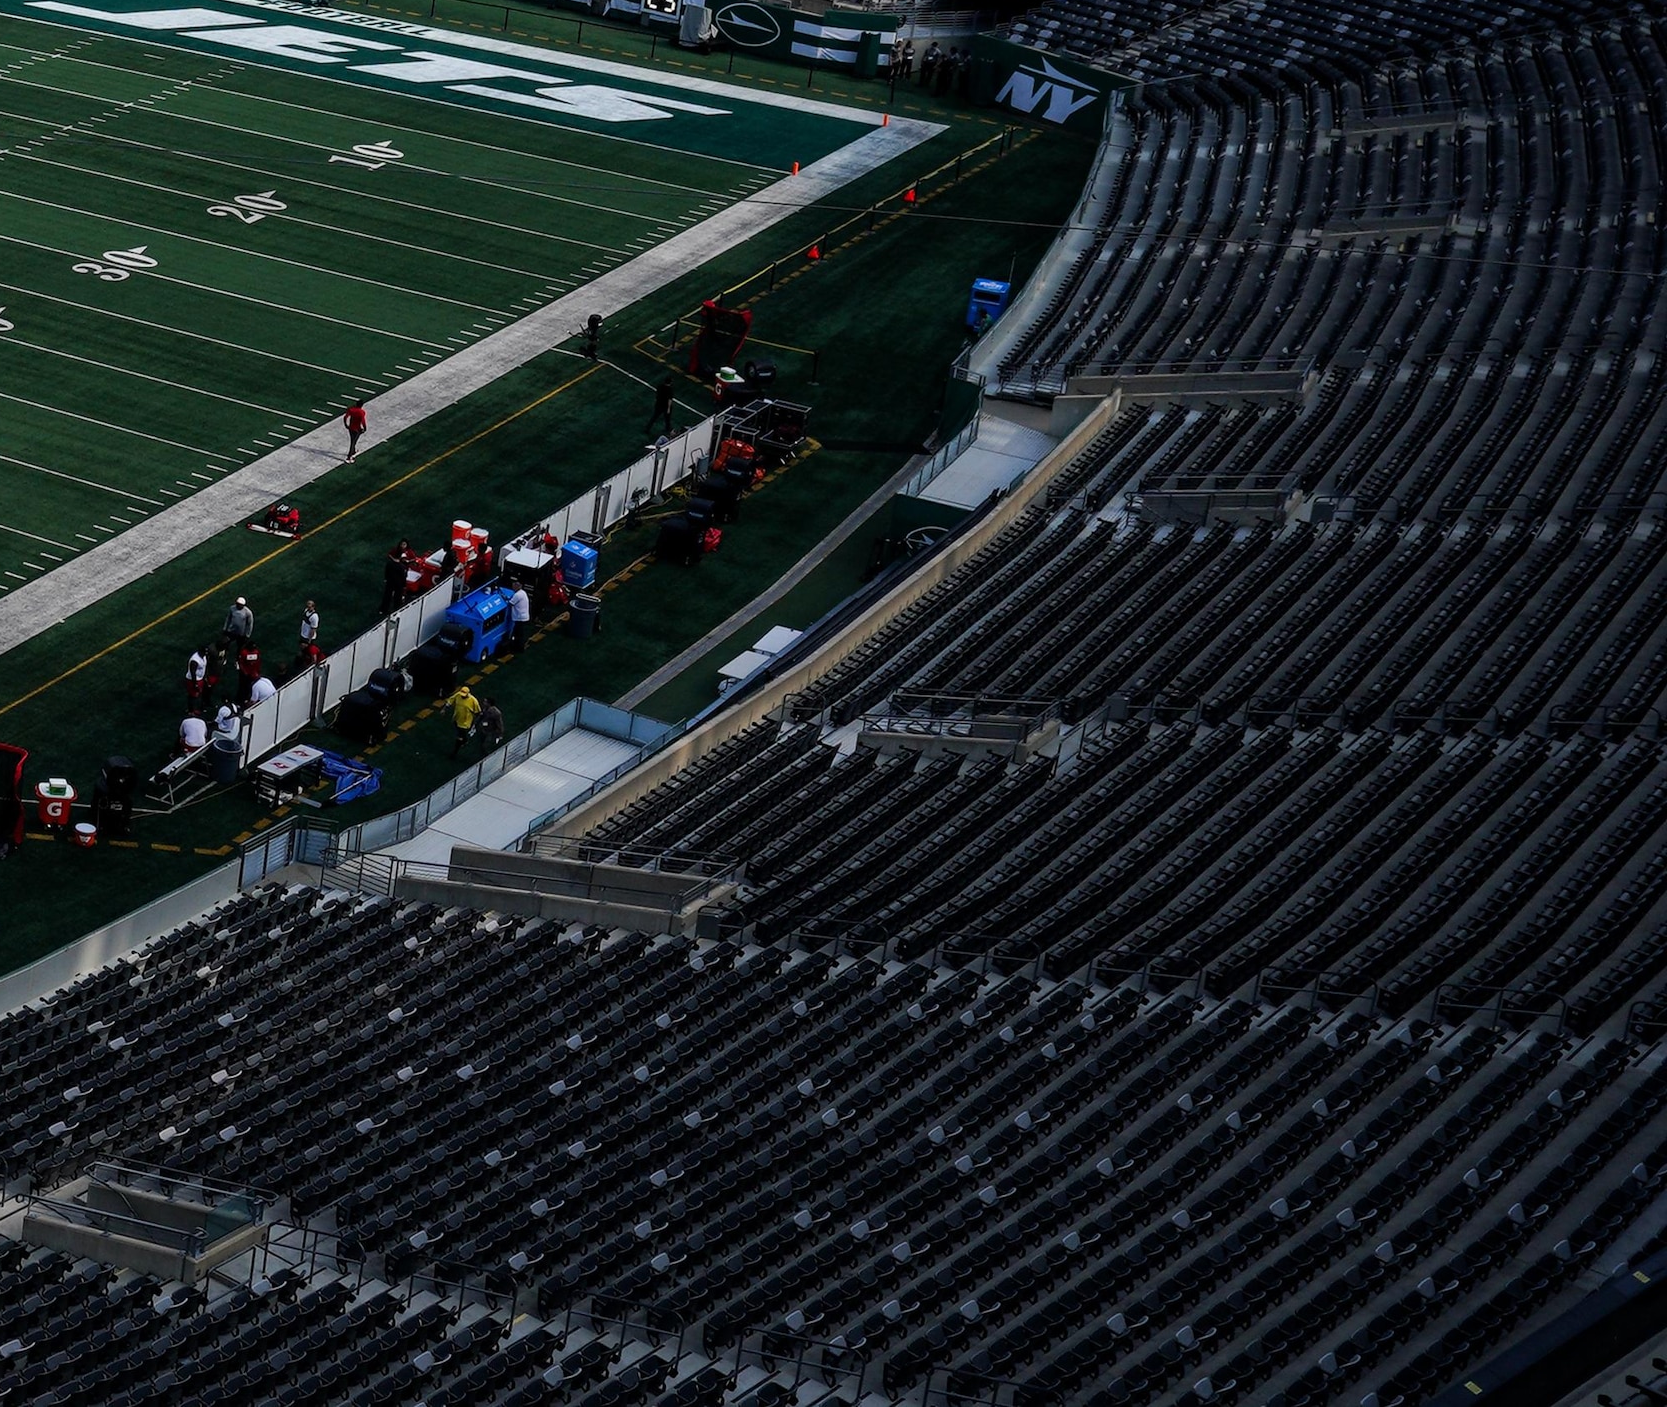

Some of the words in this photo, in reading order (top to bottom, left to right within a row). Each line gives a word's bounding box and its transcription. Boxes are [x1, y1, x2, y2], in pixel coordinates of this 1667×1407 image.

[23, 0, 732, 122] JETS
[329, 142, 405, 171] 10
[207, 193, 287, 224] 20
[72, 249, 159, 282] 30
